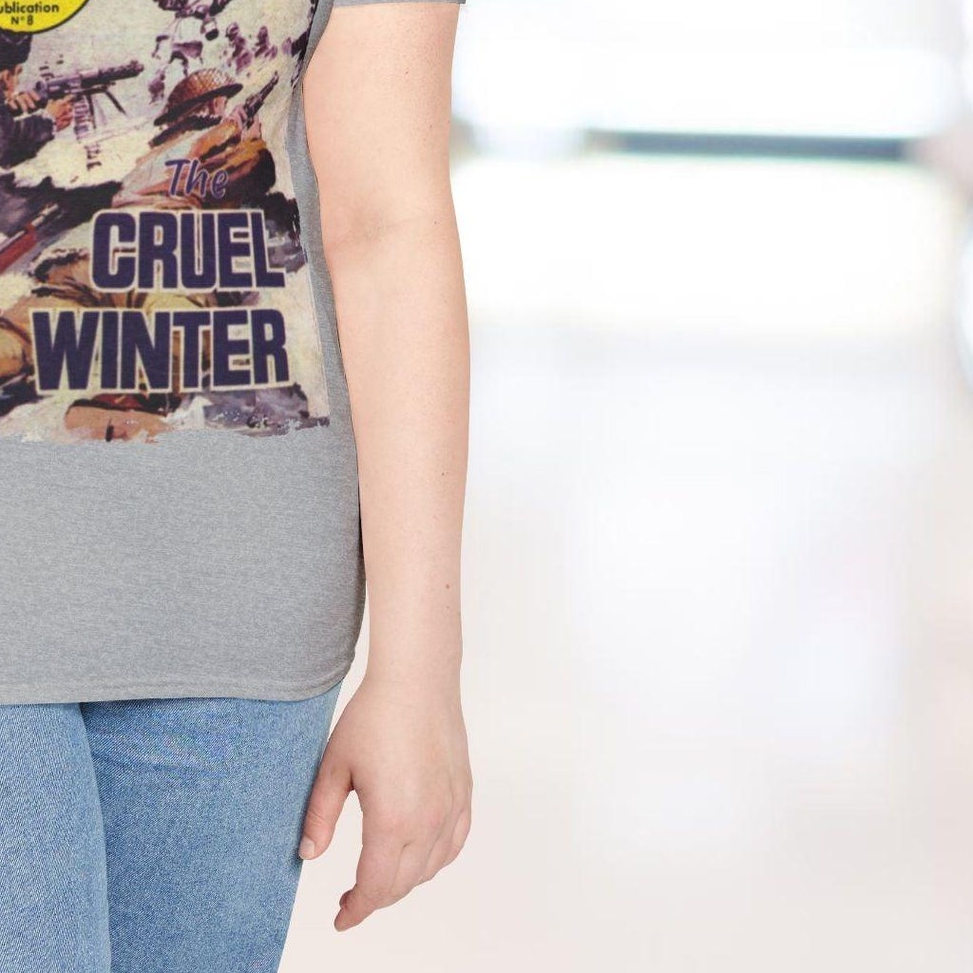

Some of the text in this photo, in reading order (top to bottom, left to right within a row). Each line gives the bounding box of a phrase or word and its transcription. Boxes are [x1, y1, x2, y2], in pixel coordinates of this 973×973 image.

[164, 159, 229, 199] The
[92, 210, 286, 291] CRUEL
[30, 308, 293, 393] WINTER
